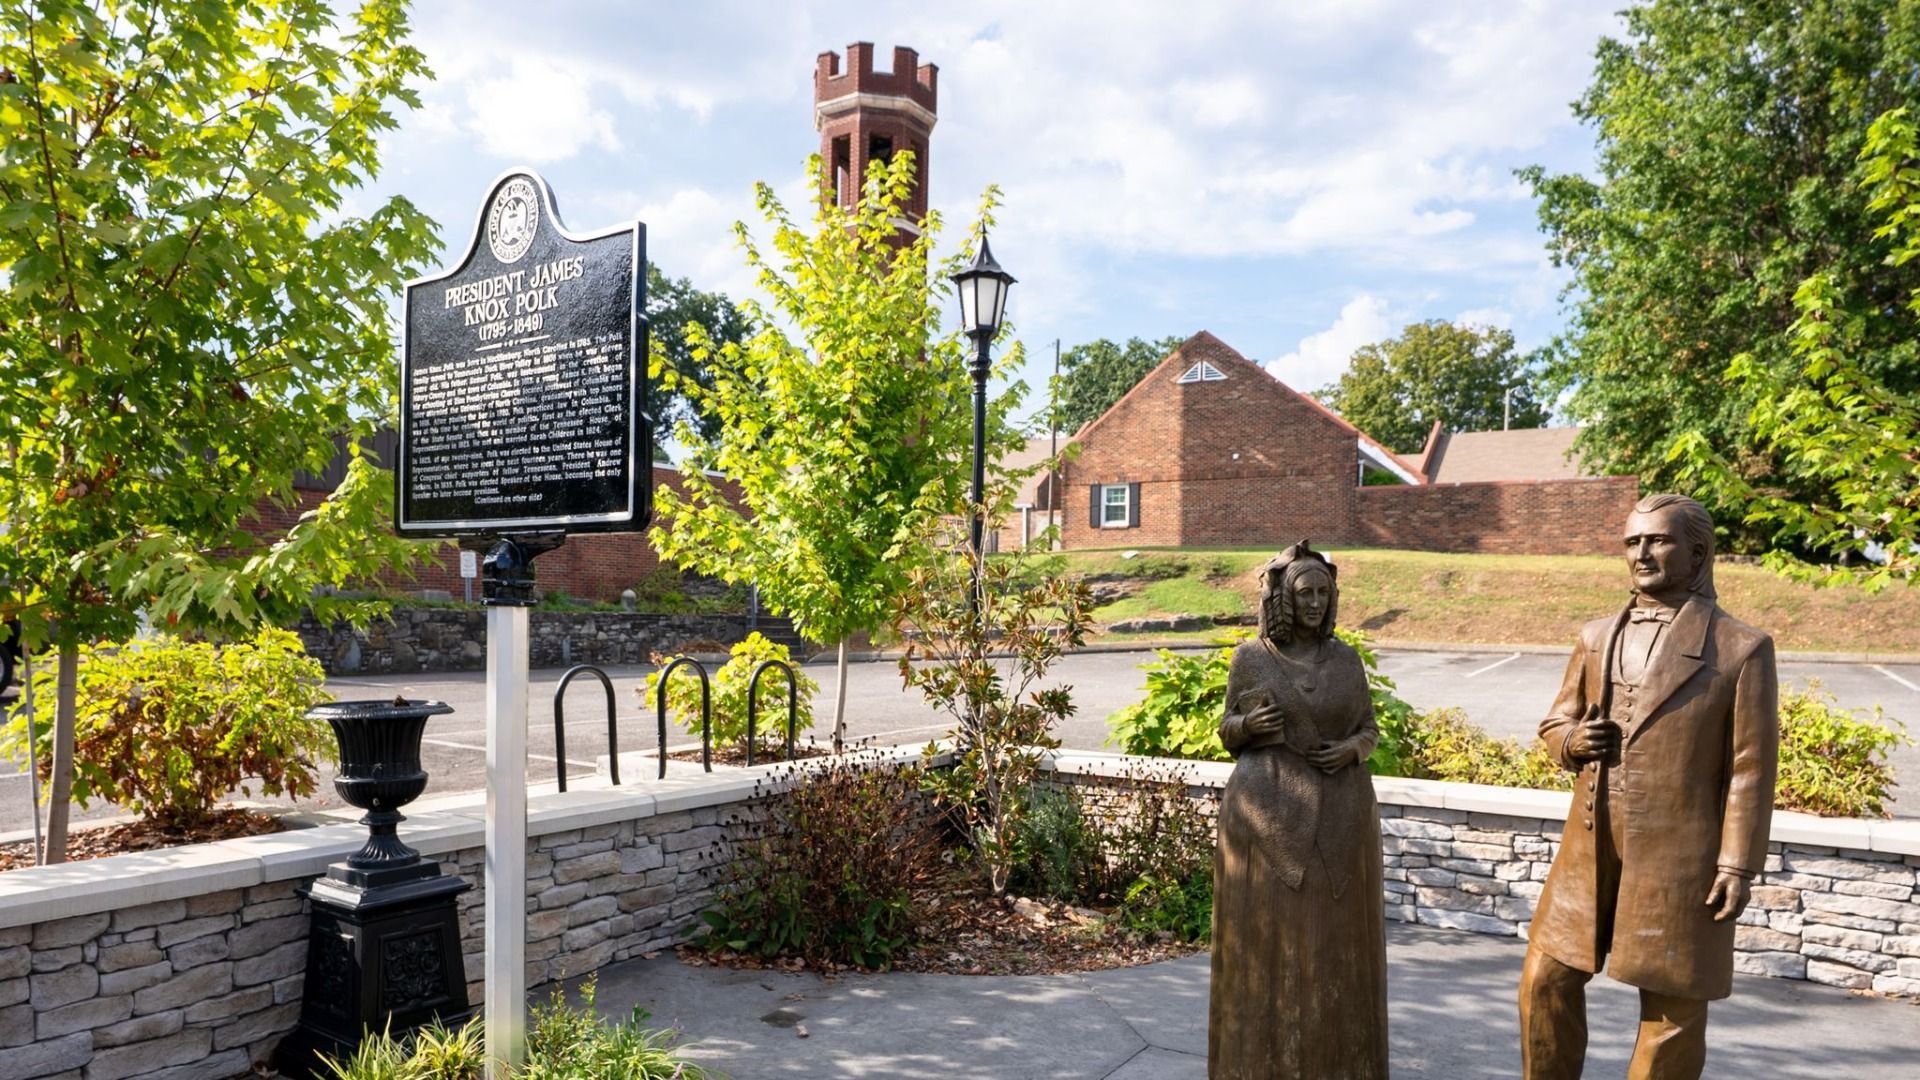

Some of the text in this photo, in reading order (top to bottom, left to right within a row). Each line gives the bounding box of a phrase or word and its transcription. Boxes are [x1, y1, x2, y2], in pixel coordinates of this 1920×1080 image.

[445, 257, 584, 308] PRESIDENT JAMES
[464, 286, 559, 326] KNOX POLK
[478, 314, 544, 340] (1795-1849)
[595, 334, 606, 344] The
[609, 332, 622, 342] Polk
[565, 409, 576, 417] the
[578, 405, 601, 415] elected
[604, 403, 621, 412] Clerk
[552, 442, 571, 451] United
[573, 440, 591, 449] States
[594, 438, 612, 447] House
[566, 451, 584, 459] There
[562, 460, 590, 469] President
[596, 457, 621, 466] Andrew
[606, 468, 621, 477] only
